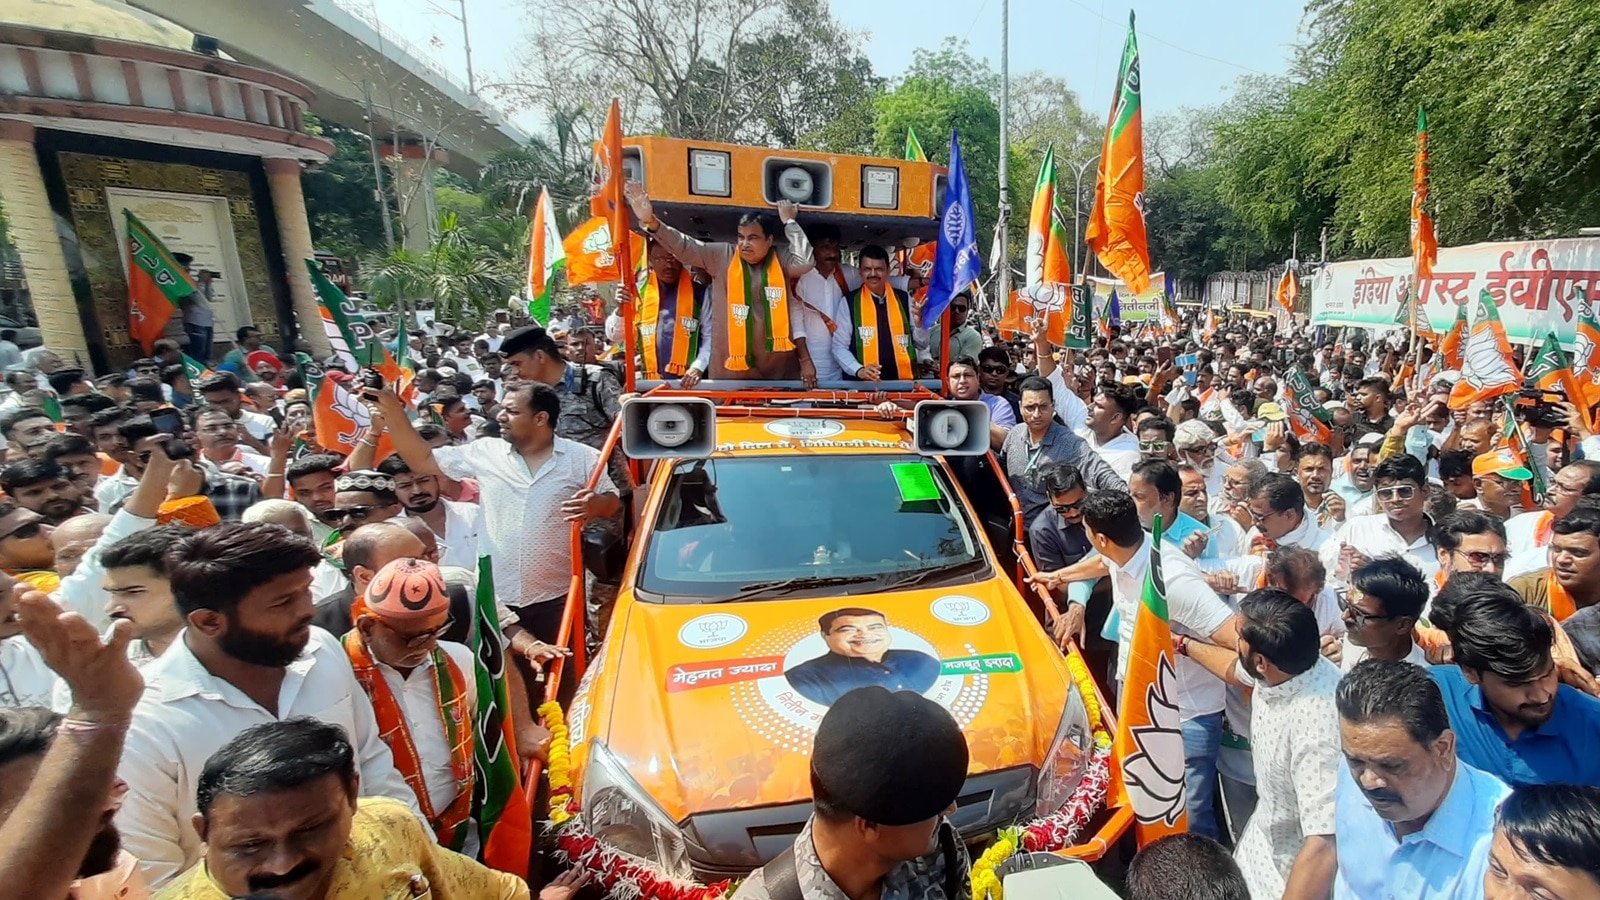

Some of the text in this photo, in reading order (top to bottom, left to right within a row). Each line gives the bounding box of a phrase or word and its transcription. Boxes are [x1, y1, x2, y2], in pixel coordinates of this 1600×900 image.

[1352, 266, 1394, 308] इंडिया
[1119, 297, 1160, 311] नतीनजी
[982, 657, 1015, 669] इरादा
[672, 662, 777, 685] मेहनत ज्यादा
